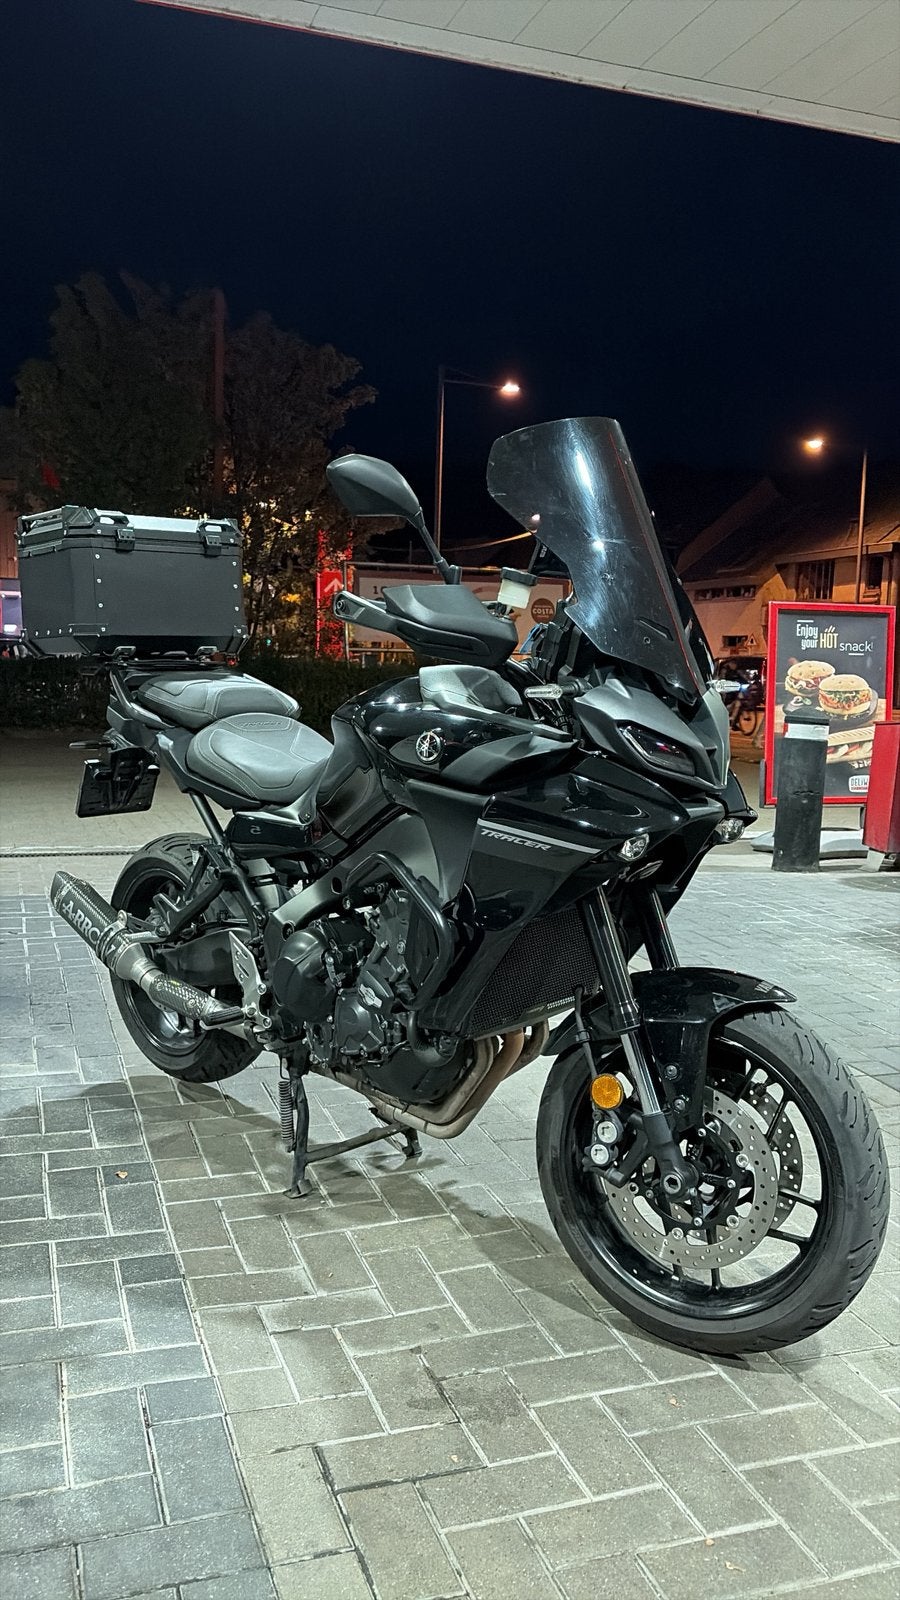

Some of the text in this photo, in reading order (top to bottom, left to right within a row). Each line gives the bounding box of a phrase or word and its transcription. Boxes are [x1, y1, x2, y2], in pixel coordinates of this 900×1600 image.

[532, 608, 554, 616] COSTA
[796, 624, 818, 639] Enjoy
[801, 639, 818, 650] your
[820, 633, 838, 649] HOT
[481, 828, 552, 851] TRACER
